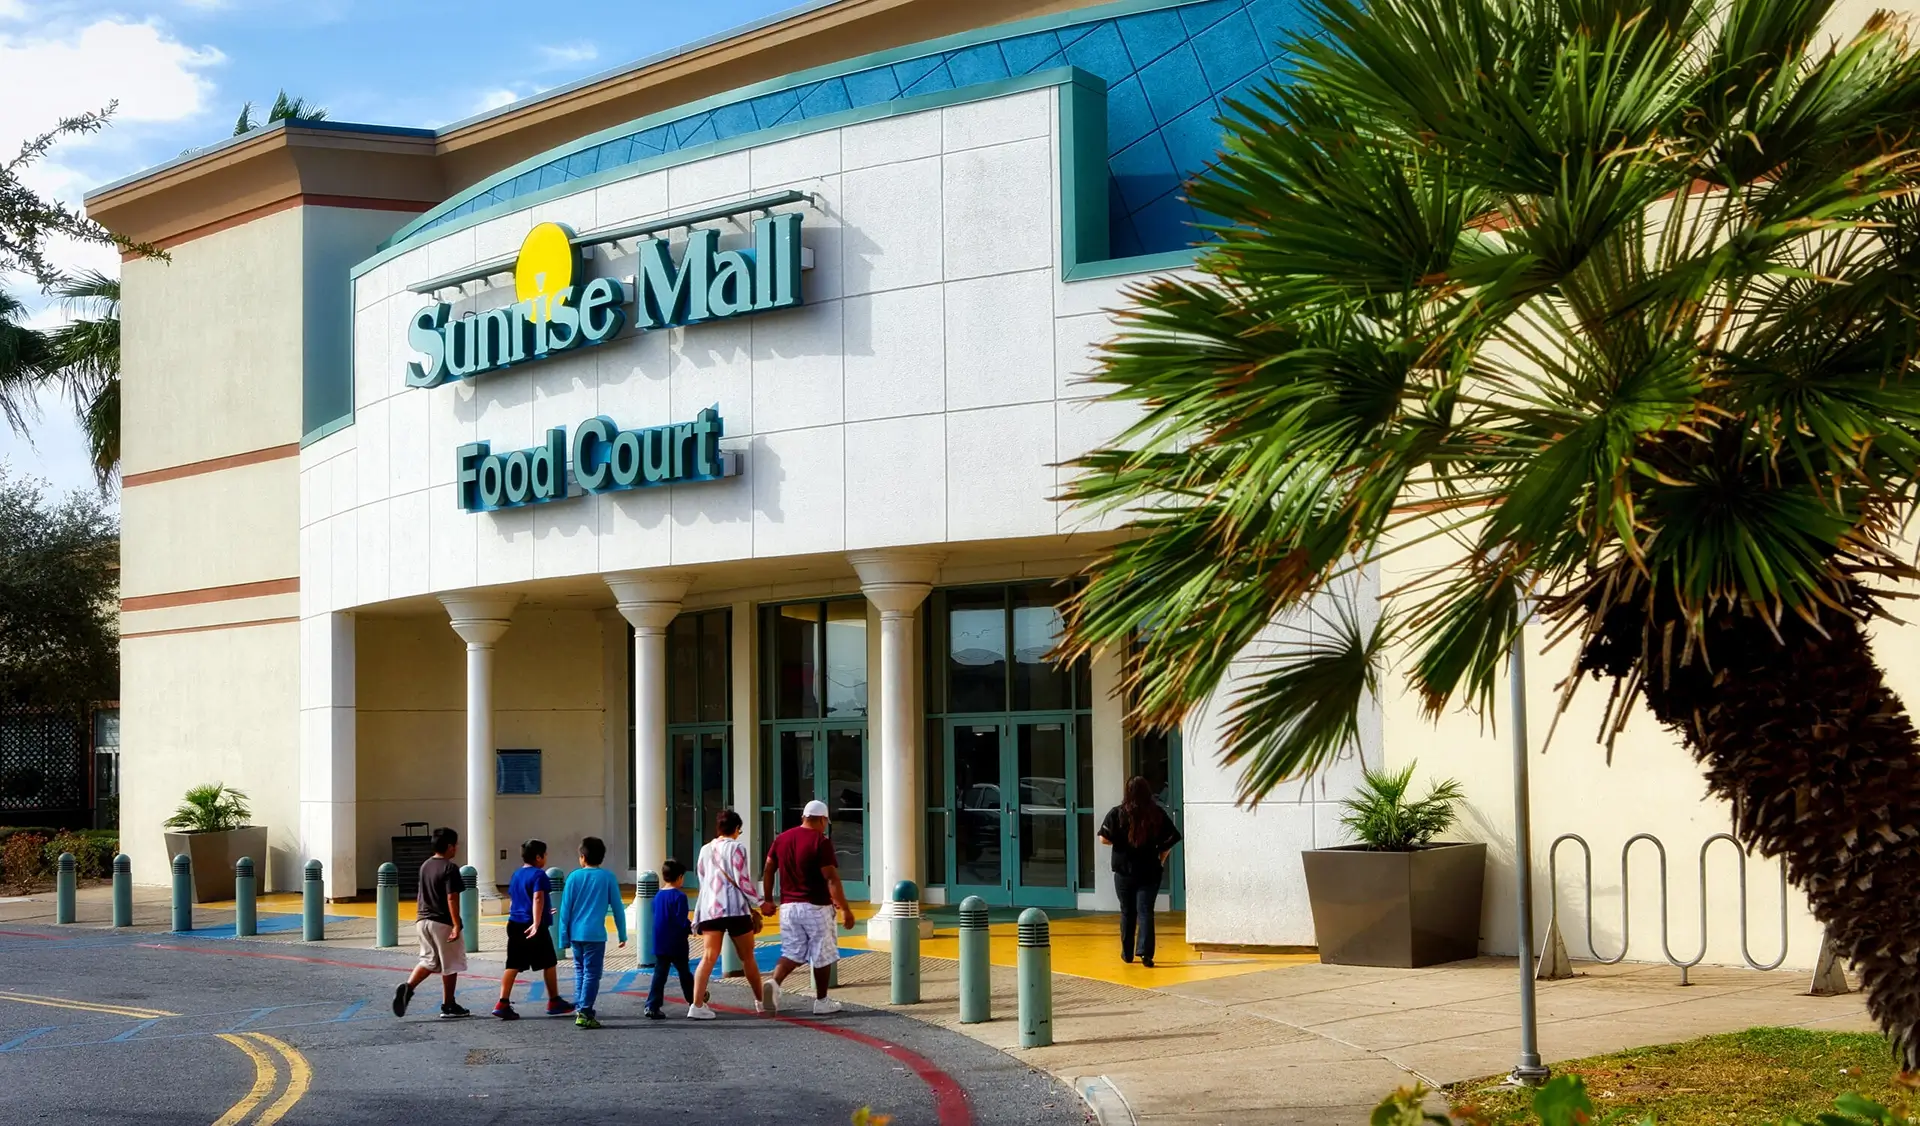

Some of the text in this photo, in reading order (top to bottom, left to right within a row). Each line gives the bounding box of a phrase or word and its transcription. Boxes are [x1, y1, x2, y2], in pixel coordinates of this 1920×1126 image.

[405, 213, 802, 388] Sunrise Mall
[457, 408, 722, 511] Food Court
